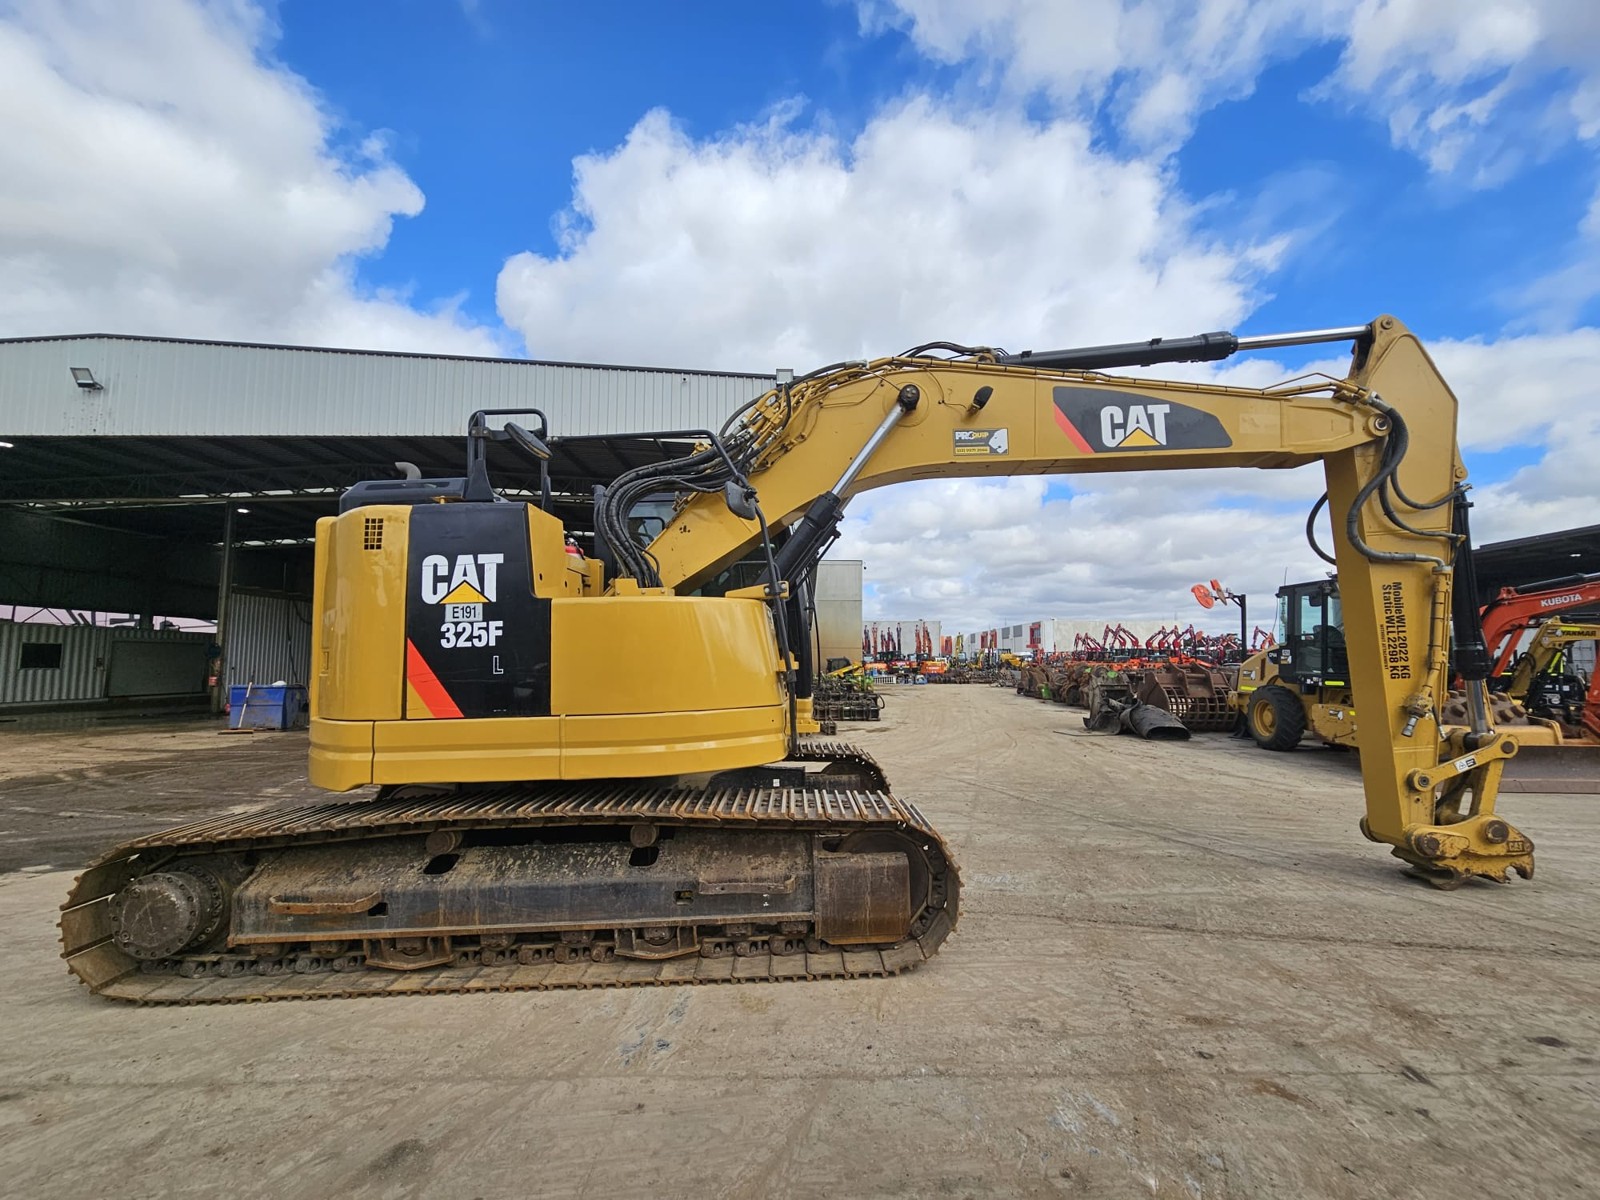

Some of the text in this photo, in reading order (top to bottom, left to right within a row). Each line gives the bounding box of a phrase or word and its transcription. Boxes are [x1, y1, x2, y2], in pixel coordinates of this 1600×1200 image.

[1100, 404, 1170, 448] CAT
[421, 553, 504, 604] CAT
[1541, 593, 1582, 607] KUBOTA
[452, 606, 477, 619] E191
[440, 621, 504, 648] 325F
[493, 655, 504, 675] L
[1390, 665, 1401, 680] KG
[1400, 665, 1411, 679] KG
